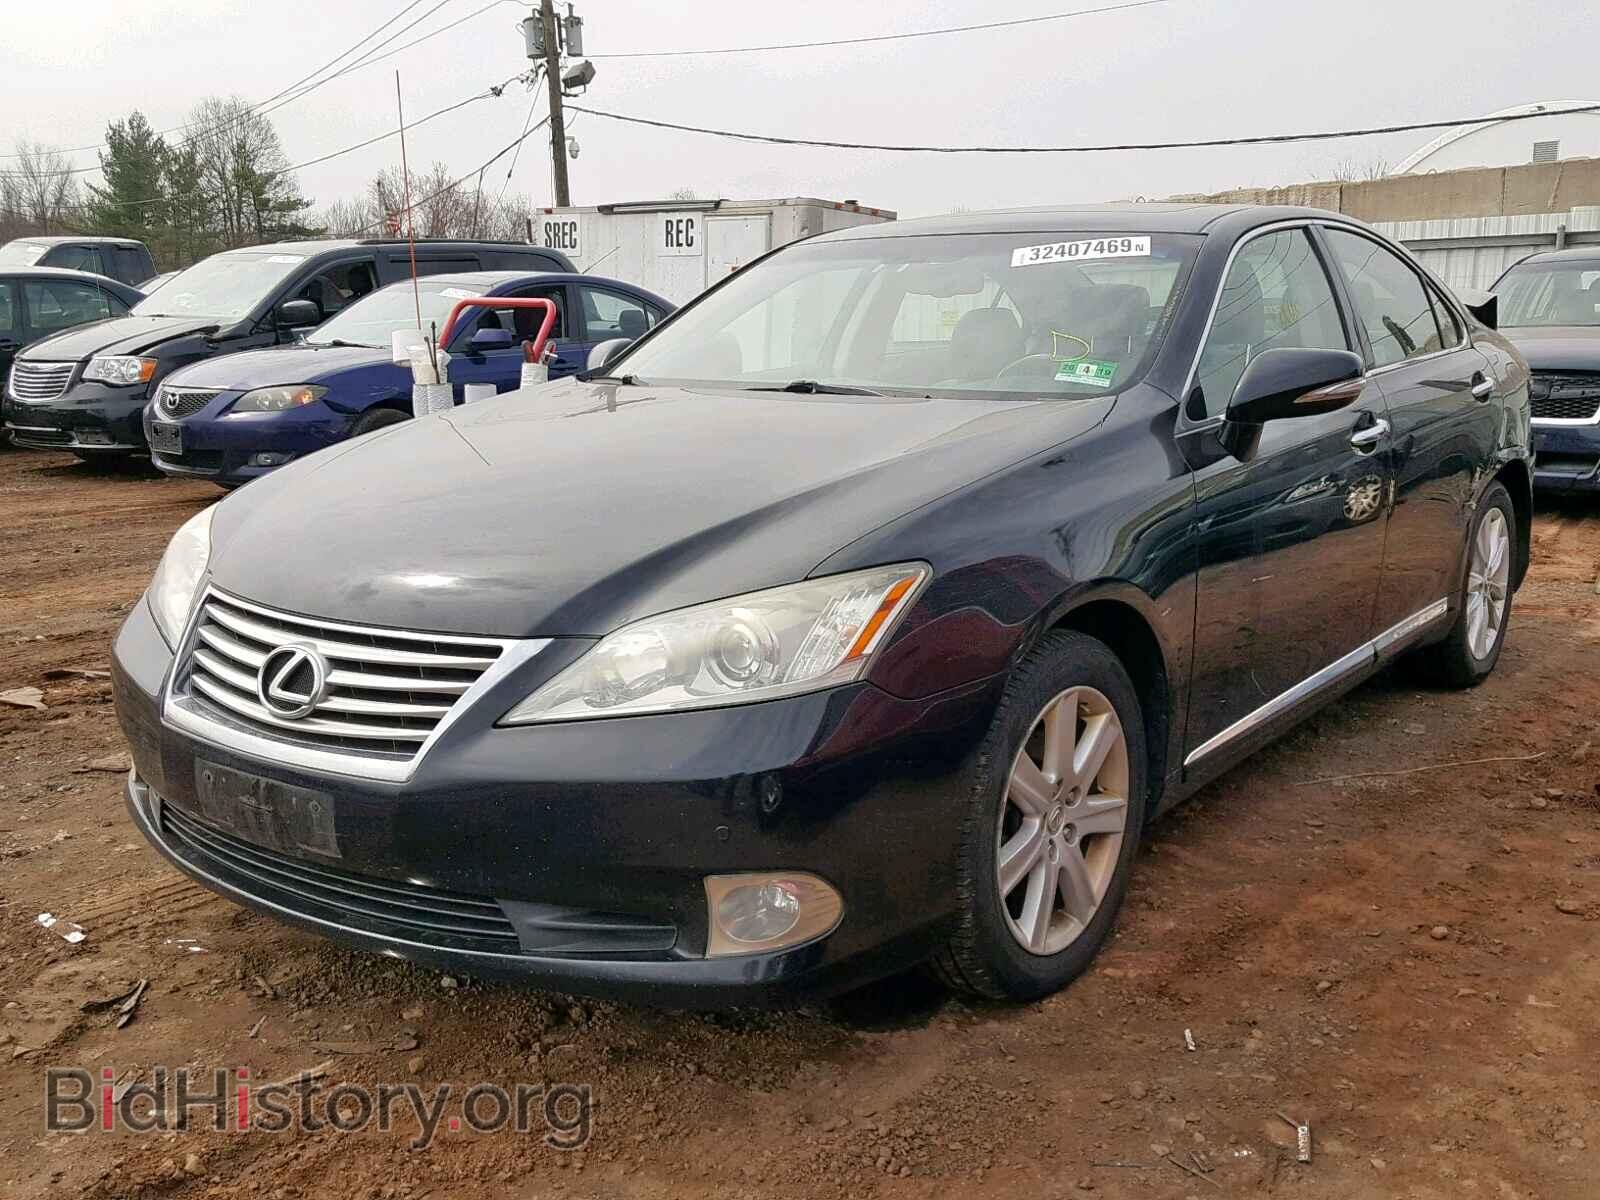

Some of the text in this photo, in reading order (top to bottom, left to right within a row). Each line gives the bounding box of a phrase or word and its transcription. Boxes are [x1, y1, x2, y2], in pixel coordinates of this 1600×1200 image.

[544, 221, 577, 249] SREC
[665, 218, 694, 247] REC
[1029, 238, 1132, 261] 32407469
[1135, 243, 1144, 252] N
